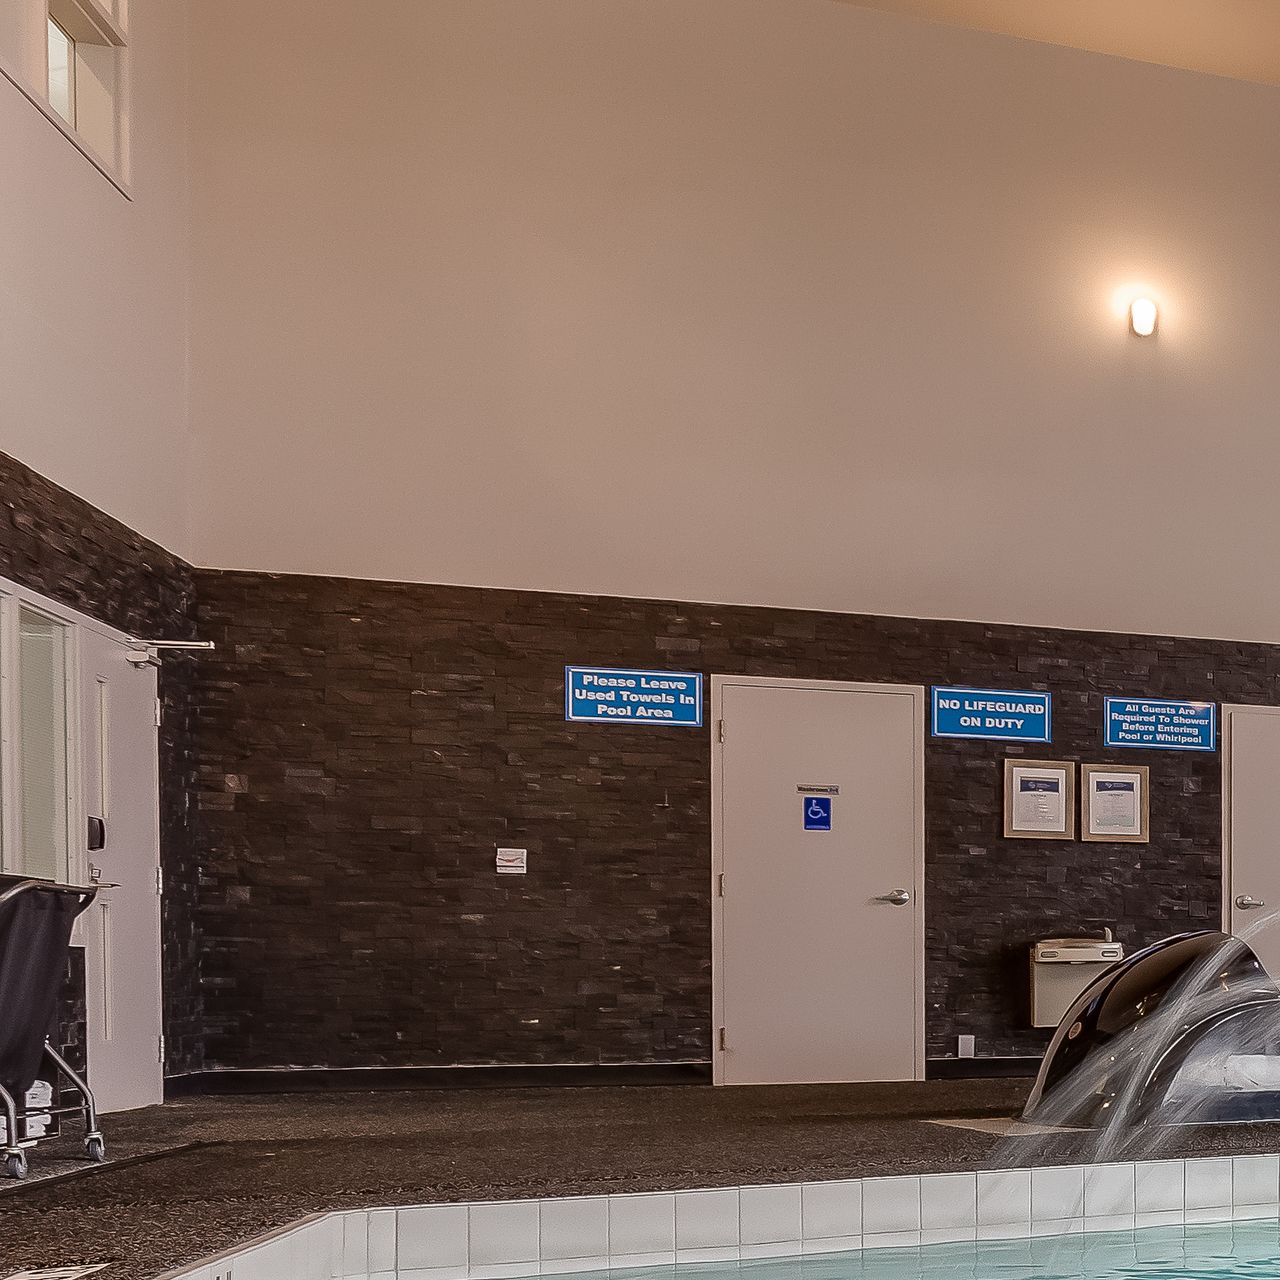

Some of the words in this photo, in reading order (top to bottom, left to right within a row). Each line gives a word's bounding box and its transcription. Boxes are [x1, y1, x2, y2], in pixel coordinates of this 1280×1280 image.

[583, 674, 636, 688] Please
[641, 677, 687, 690] Leave
[575, 689, 615, 701] Used
[620, 691, 675, 704] Towels
[679, 694, 695, 705] In
[597, 704, 631, 717] Pool
[636, 706, 673, 718] Area
[939, 699, 960, 709] NO
[964, 700, 1045, 714] LIFEGUARD
[1125, 704, 1139, 712] All
[1141, 704, 1176, 715] Guests
[1178, 706, 1196, 715] Are
[960, 716, 981, 727] ON
[985, 718, 1025, 729] DUTY
[1111, 712, 1156, 723] Required
[1158, 715, 1170, 723] To
[1172, 716, 1209, 725] Shower
[1122, 722, 1155, 731] Before
[1157, 724, 1199, 736] Entering
[1118, 731, 1140, 740] Pool
[1142, 733, 1153, 741] or
[1155, 733, 1202, 744] Whirlpool
